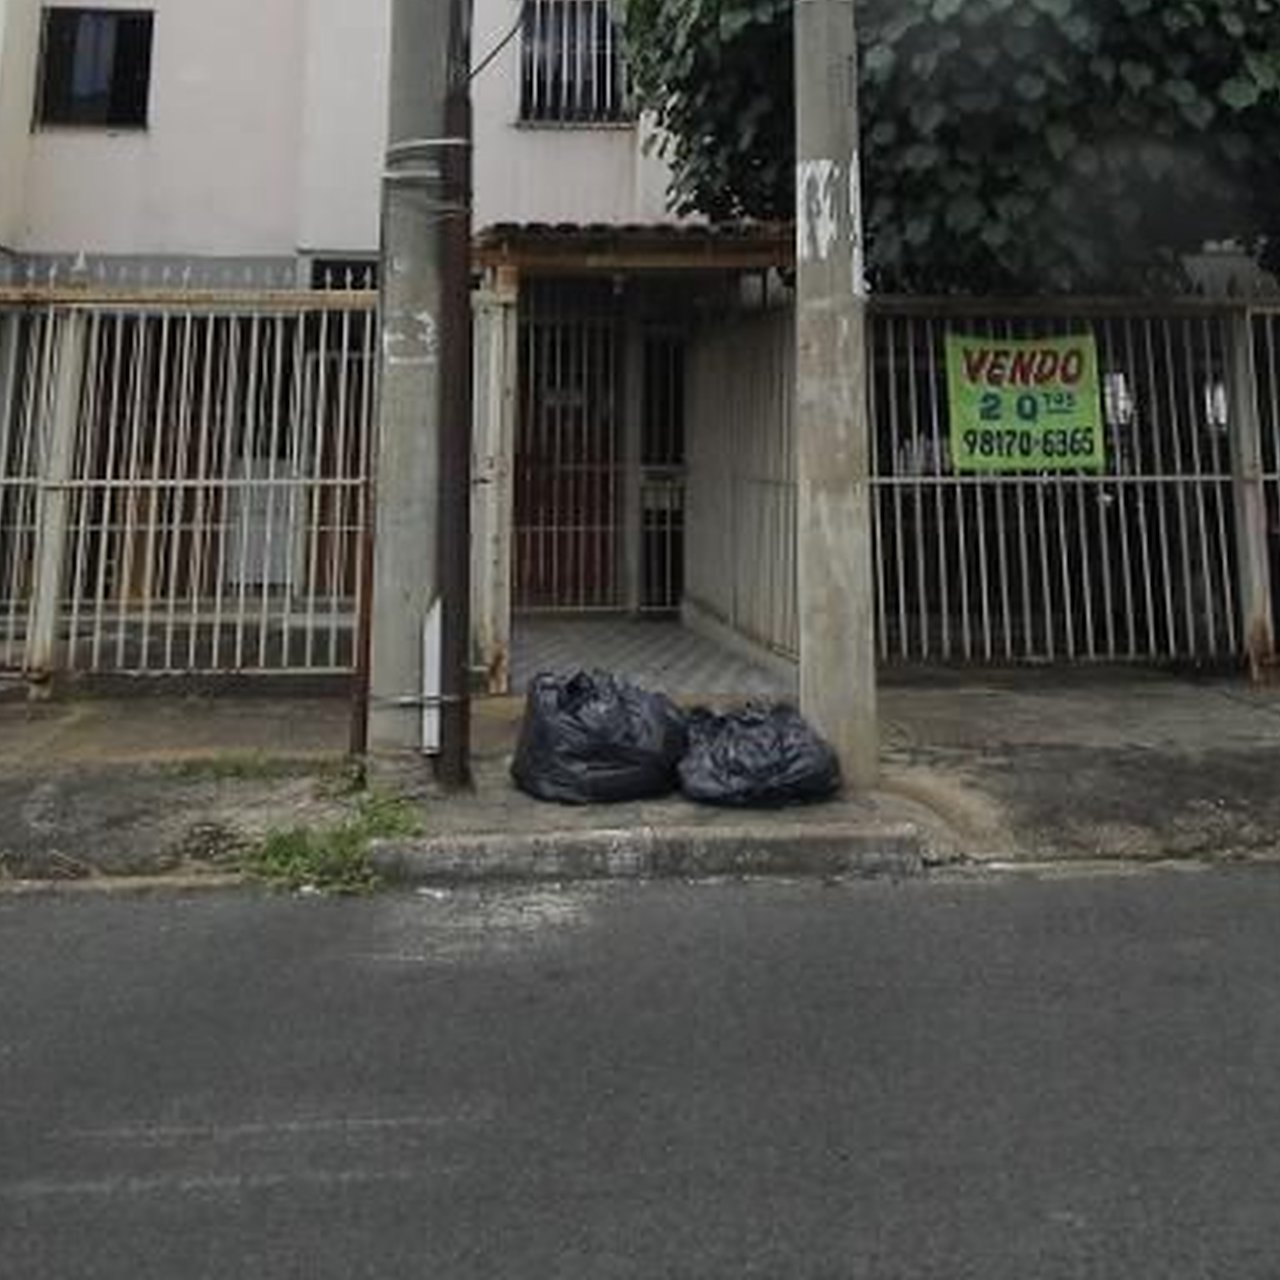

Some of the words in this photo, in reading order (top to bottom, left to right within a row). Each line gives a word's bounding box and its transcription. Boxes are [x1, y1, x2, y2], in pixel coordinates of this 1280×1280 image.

[963, 349, 1082, 386] VENDO
[980, 393, 1001, 421] 2
[963, 427, 1095, 458] 98170-6365
